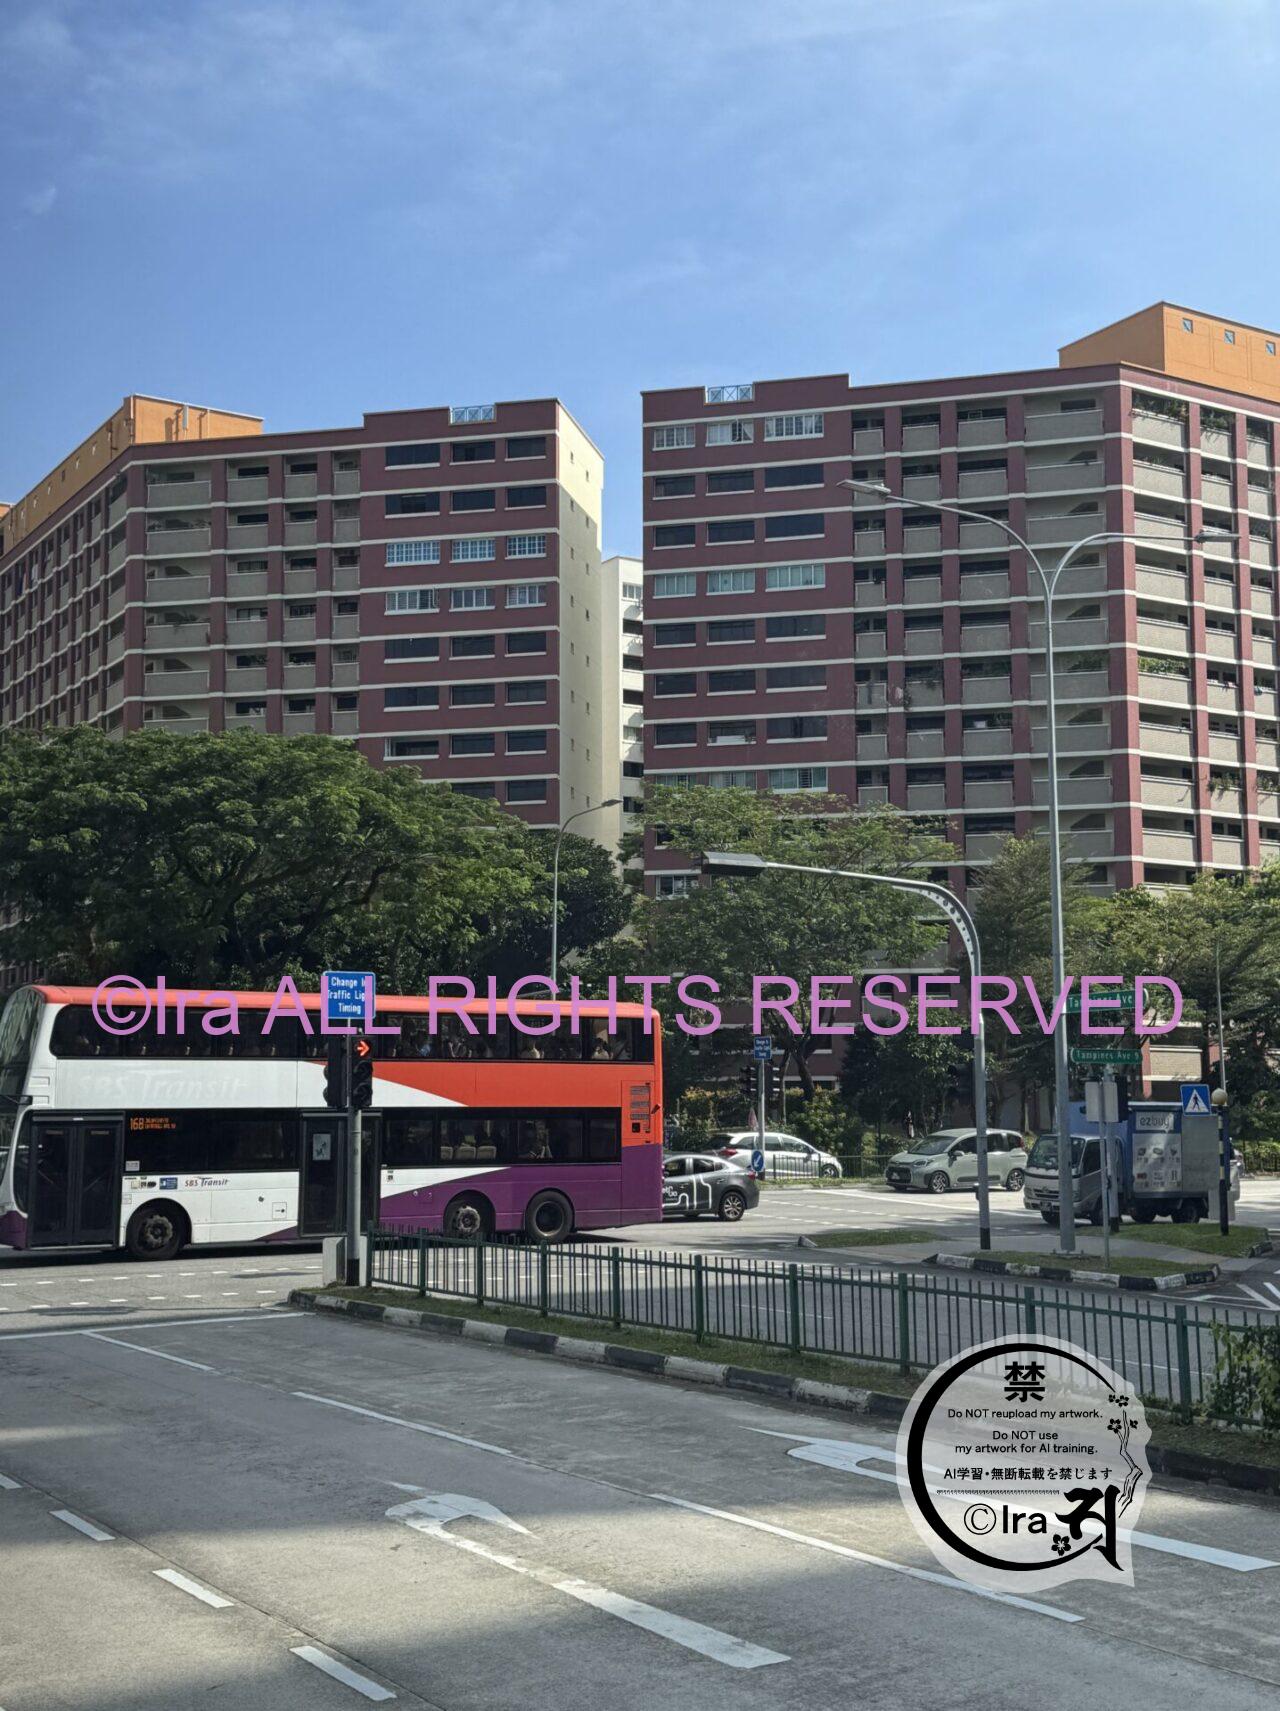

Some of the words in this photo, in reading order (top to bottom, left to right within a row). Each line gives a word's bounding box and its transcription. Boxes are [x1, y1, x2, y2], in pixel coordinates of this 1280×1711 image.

[331, 977, 358, 989] Change
[338, 1002, 362, 1015] Timing
[1076, 1050, 1114, 1061] Tampines
[1117, 1050, 1131, 1060] Ave
[137, 1069, 248, 1101] Transit
[184, 1179, 199, 1188] SBS
[200, 1177, 230, 1187] Transit
